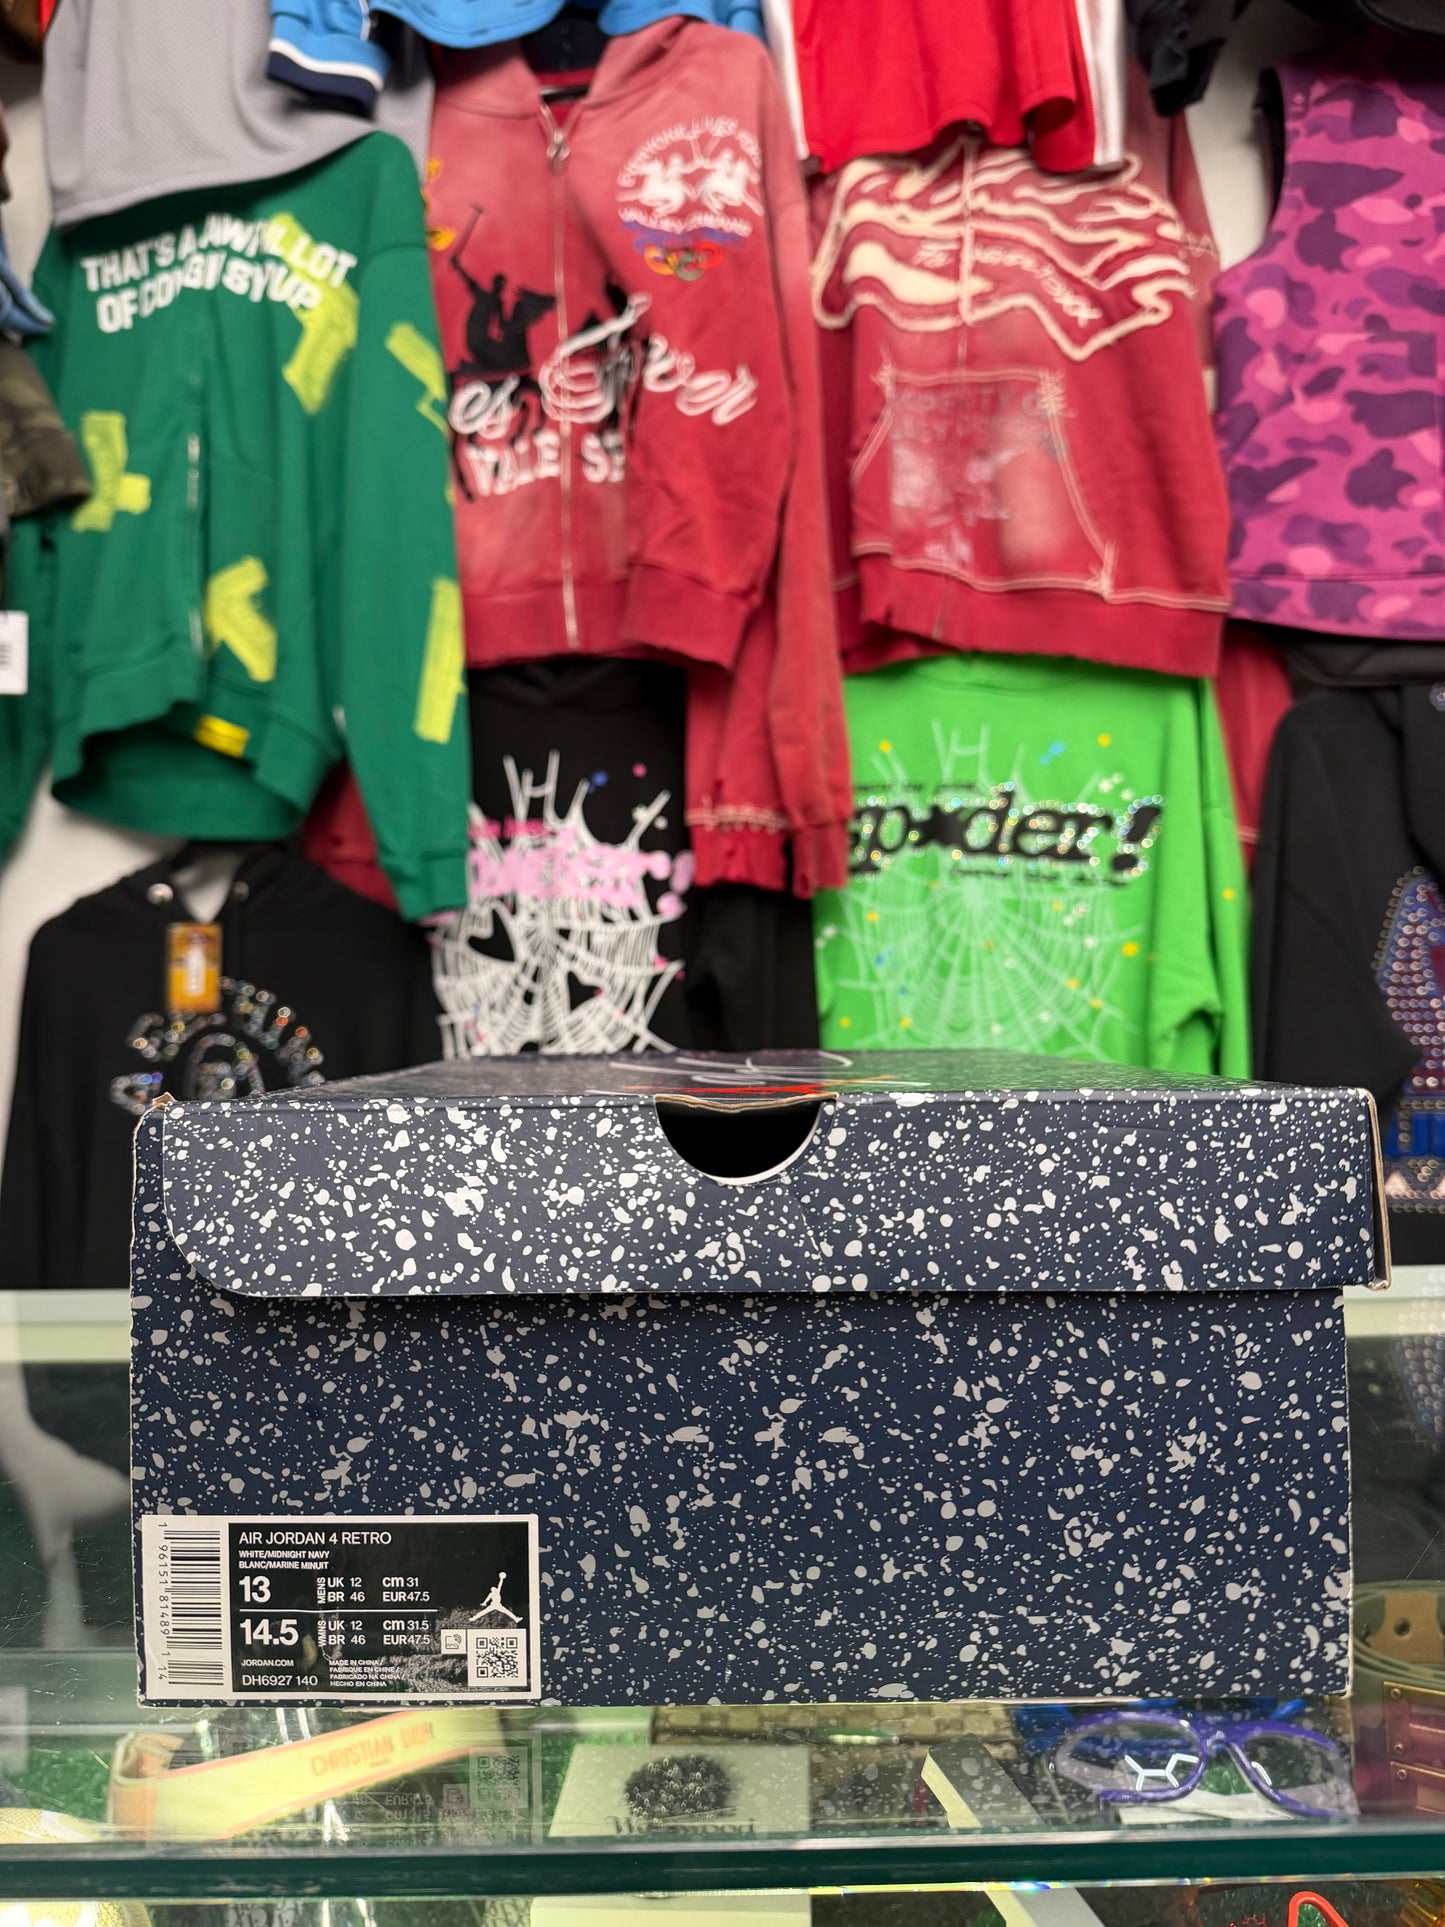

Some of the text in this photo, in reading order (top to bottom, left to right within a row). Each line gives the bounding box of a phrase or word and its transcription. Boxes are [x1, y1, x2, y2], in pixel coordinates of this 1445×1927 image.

[80, 232, 177, 292] THAT'S
[287, 232, 359, 289] LOT
[95, 286, 139, 334] OF
[239, 1531, 392, 1545] AIR JORDAN 4 RETRO
[238, 1550, 331, 1559] WHITE/MIDNIGHT NAVY
[238, 1560, 330, 1570] BLANC/MARINE MINUIT
[327, 1576, 419, 1588] UK 12 cm 31
[239, 1575, 271, 1603] 13
[317, 1576, 326, 1604] MENS
[327, 1591, 345, 1602] BR
[350, 1591, 366, 1602] 46
[328, 1619, 429, 1631] UK 12 cm 31.5
[239, 1618, 299, 1646] 14.5
[317, 1620, 327, 1647] WMNS
[328, 1634, 346, 1645] BR
[350, 1634, 366, 1645] 46
[241, 1659, 294, 1667] JORDAN.COM
[242, 1674, 318, 1686] DH6927 140
[310, 1721, 435, 1777] CHRISTIAN DIOR
